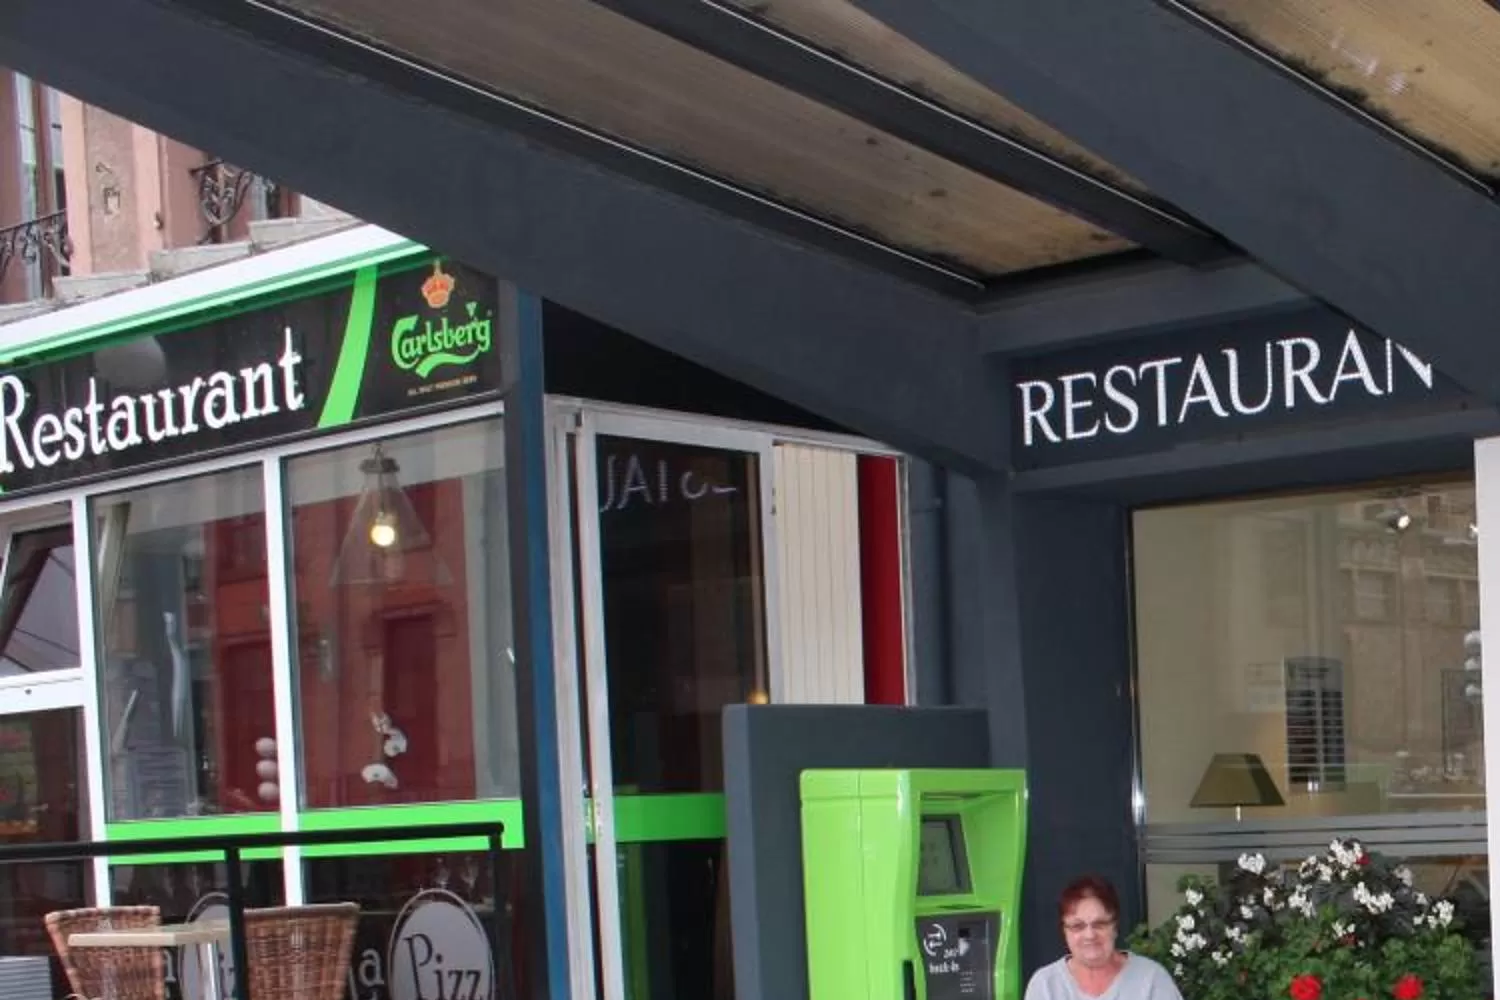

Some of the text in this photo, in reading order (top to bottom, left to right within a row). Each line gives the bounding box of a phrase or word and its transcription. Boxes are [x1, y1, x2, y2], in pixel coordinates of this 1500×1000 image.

[0, 326, 305, 474] Restaurant
[391, 314, 491, 369] Carlsberg
[1015, 328, 1434, 447] RESTAURAN
